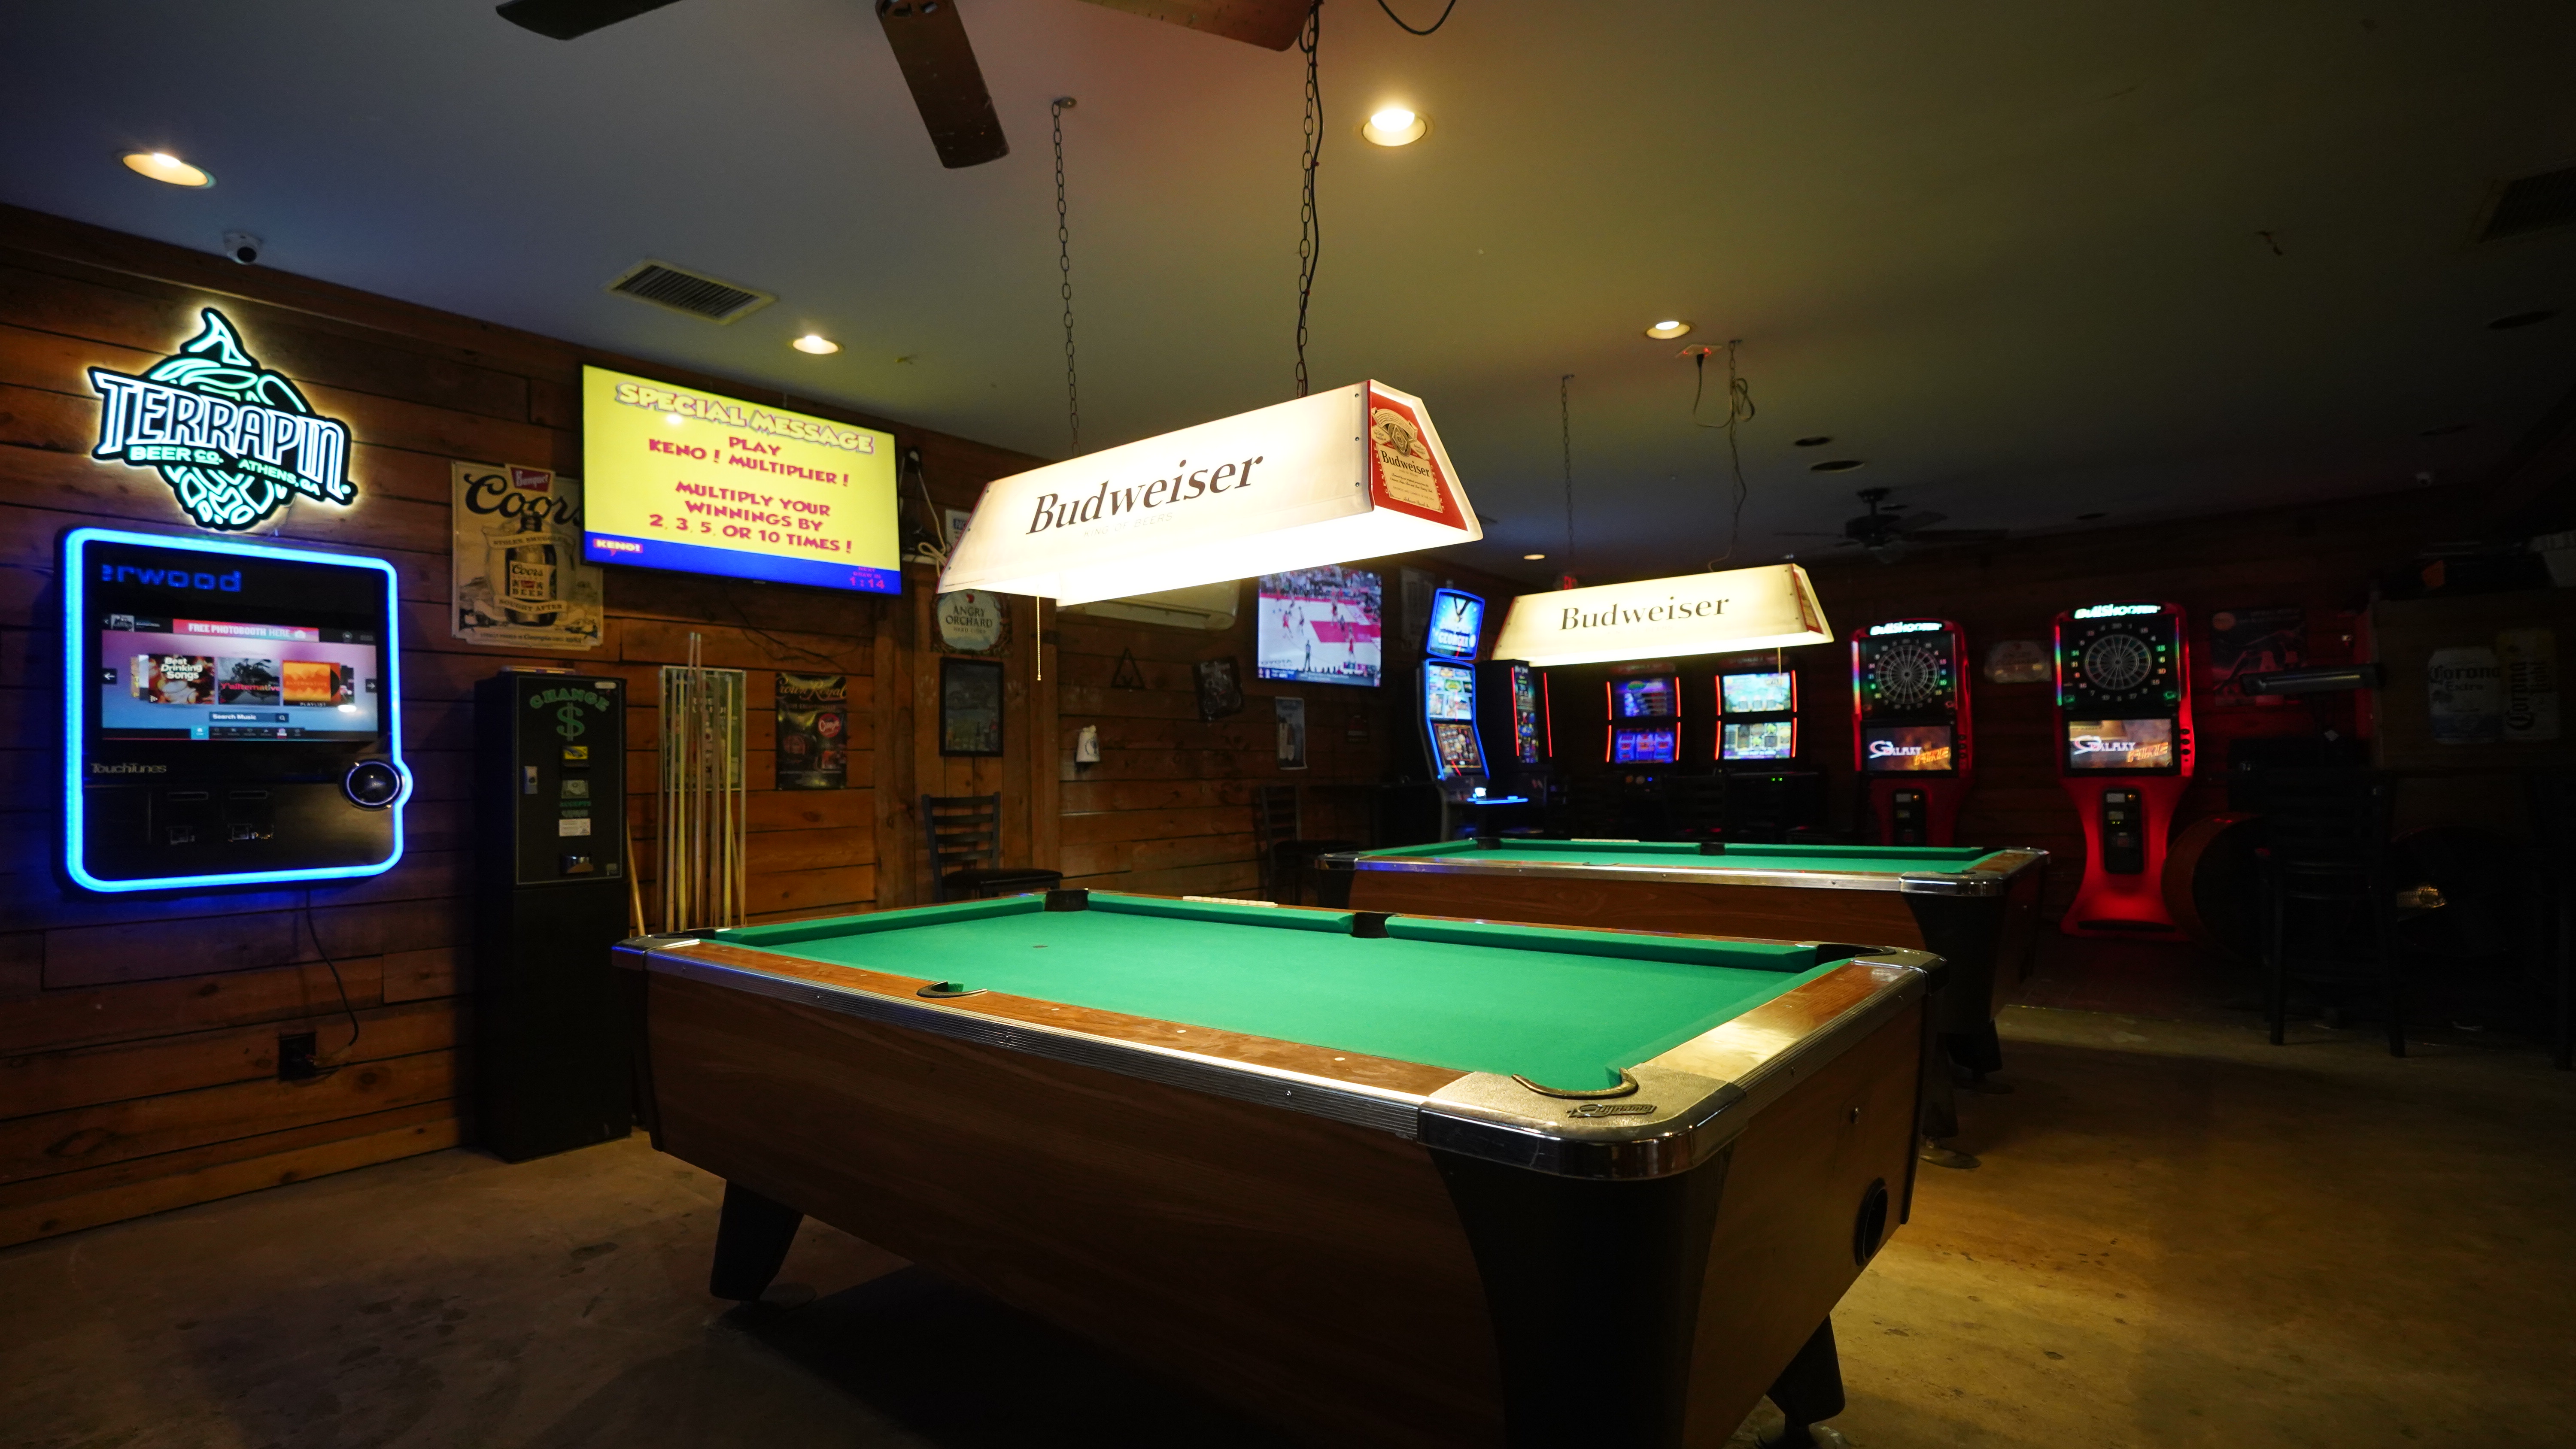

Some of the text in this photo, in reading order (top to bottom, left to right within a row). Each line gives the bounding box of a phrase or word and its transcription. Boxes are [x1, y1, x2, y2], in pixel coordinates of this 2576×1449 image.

[616, 382, 875, 455] SPECIAL MESSAGE
[91, 369, 345, 500] TERRAPIN
[729, 437, 781, 456] PLAY
[130, 446, 191, 462] BEER
[237, 458, 299, 487] ATHENS,
[299, 477, 321, 496] GA
[649, 439, 707, 460] KENO
[729, 455, 837, 485] MULTIPLIER
[1381, 450, 1430, 477] Budweiser
[675, 481, 831, 516] MULTIPLY YOUR
[1025, 455, 1264, 536] Budweiser
[685, 500, 823, 531] WINNINGS BY
[1083, 512, 1173, 538] KING OF BEERS
[596, 539, 641, 552] KENO!
[722, 525, 751, 539] OR
[758, 529, 780, 543] 10
[786, 534, 840, 551] TIMES
[849, 576, 885, 589] 1:14
[946, 615, 993, 628] ORCHARD
[954, 605, 985, 617] ANGRY
[1558, 596, 1730, 631] Budweiser
[188, 623, 290, 638] FREE PHOTOBOOTH HERE
[161, 663, 203, 673] Drinking
[164, 657, 188, 665] Best
[167, 671, 200, 682] Songs
[2429, 665, 2501, 683] Corona
[529, 687, 610, 712] CHANGE
[2506, 661, 2535, 731] Corona
[1869, 740, 1922, 759] GALAXY
[2073, 735, 2136, 755] GALAXY
[91, 763, 167, 773] TouchTunes
